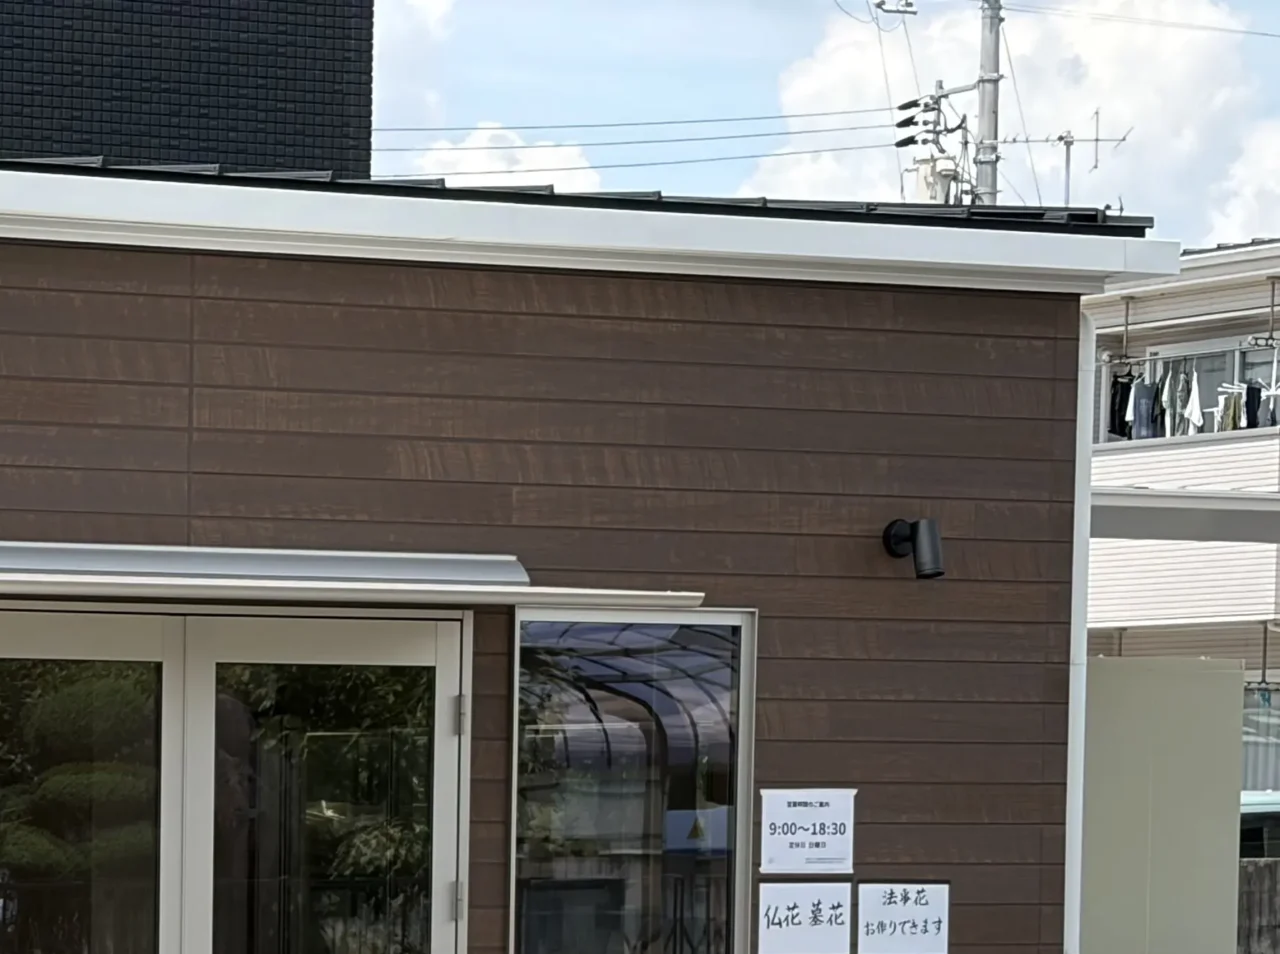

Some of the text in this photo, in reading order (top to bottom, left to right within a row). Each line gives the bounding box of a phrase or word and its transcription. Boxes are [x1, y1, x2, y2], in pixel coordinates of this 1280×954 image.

[882, 887, 929, 906] 法事花
[864, 916, 943, 936] お作りできます
